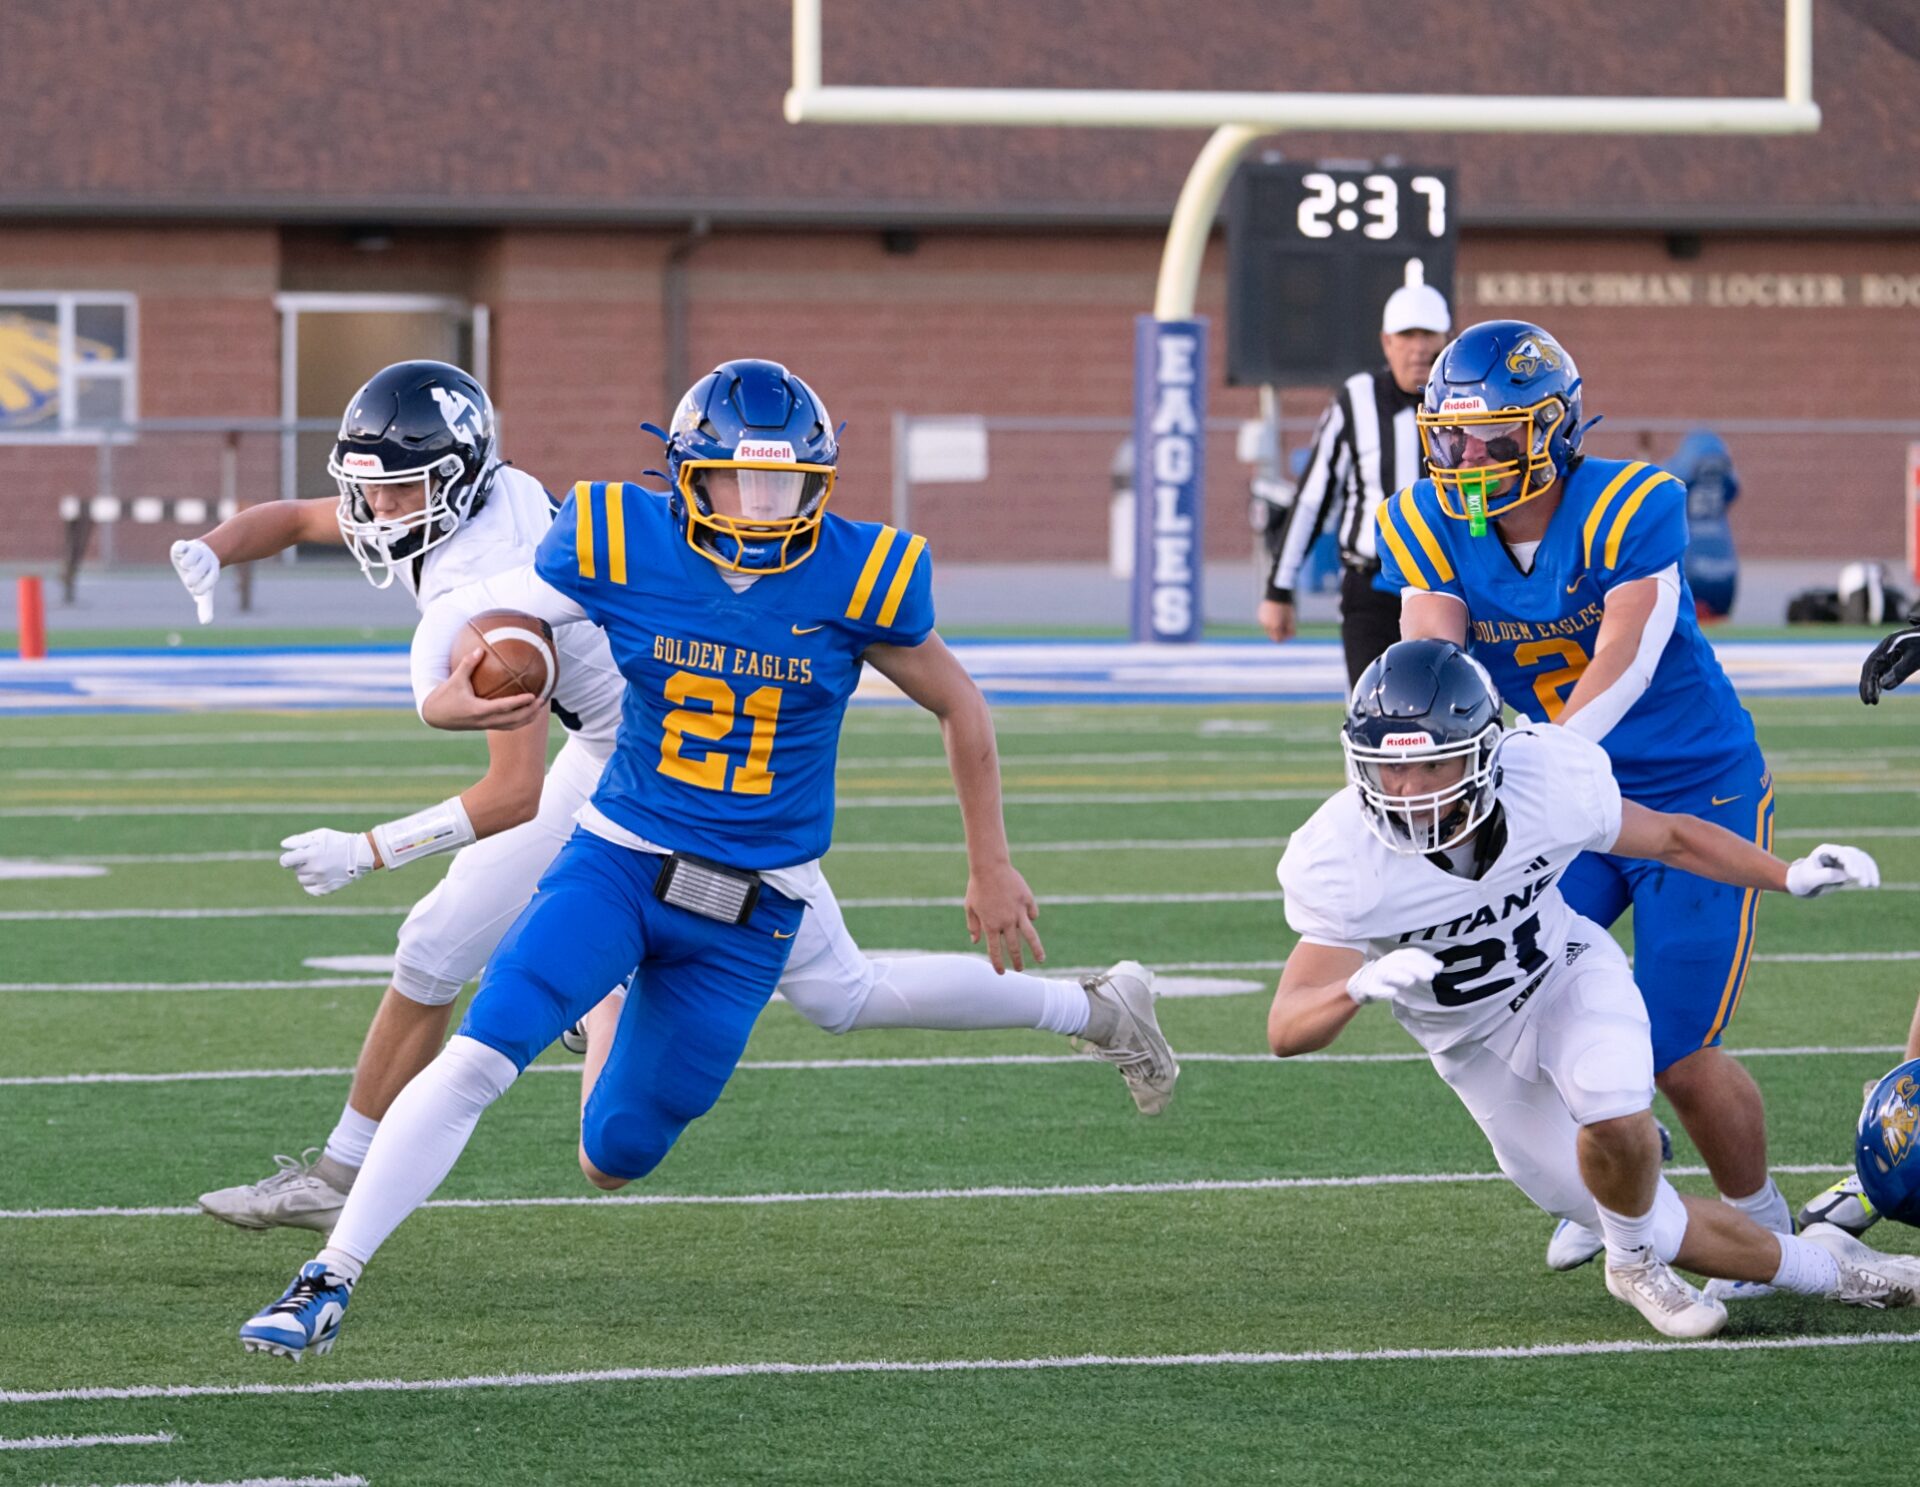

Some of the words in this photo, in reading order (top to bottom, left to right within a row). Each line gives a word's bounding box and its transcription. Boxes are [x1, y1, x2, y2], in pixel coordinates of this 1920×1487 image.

[1298, 173, 1446, 240] 2:37
[1476, 272, 1694, 307] KRETCHMAN
[1706, 272, 1844, 308] LOCKER
[1443, 400, 1480, 411] Riddell
[741, 446, 791, 459] Riddell
[1152, 334, 1197, 635] EAGLES
[1536, 602, 1604, 637] EAGLES
[654, 635, 726, 672] GOLDEN
[732, 648, 813, 684] EAGLES
[1513, 637, 1590, 724] 2
[656, 670, 783, 795] 21
[1386, 736, 1427, 747] Riddell
[1399, 871, 1560, 944] TITANS
[1431, 911, 1549, 1007] 21
